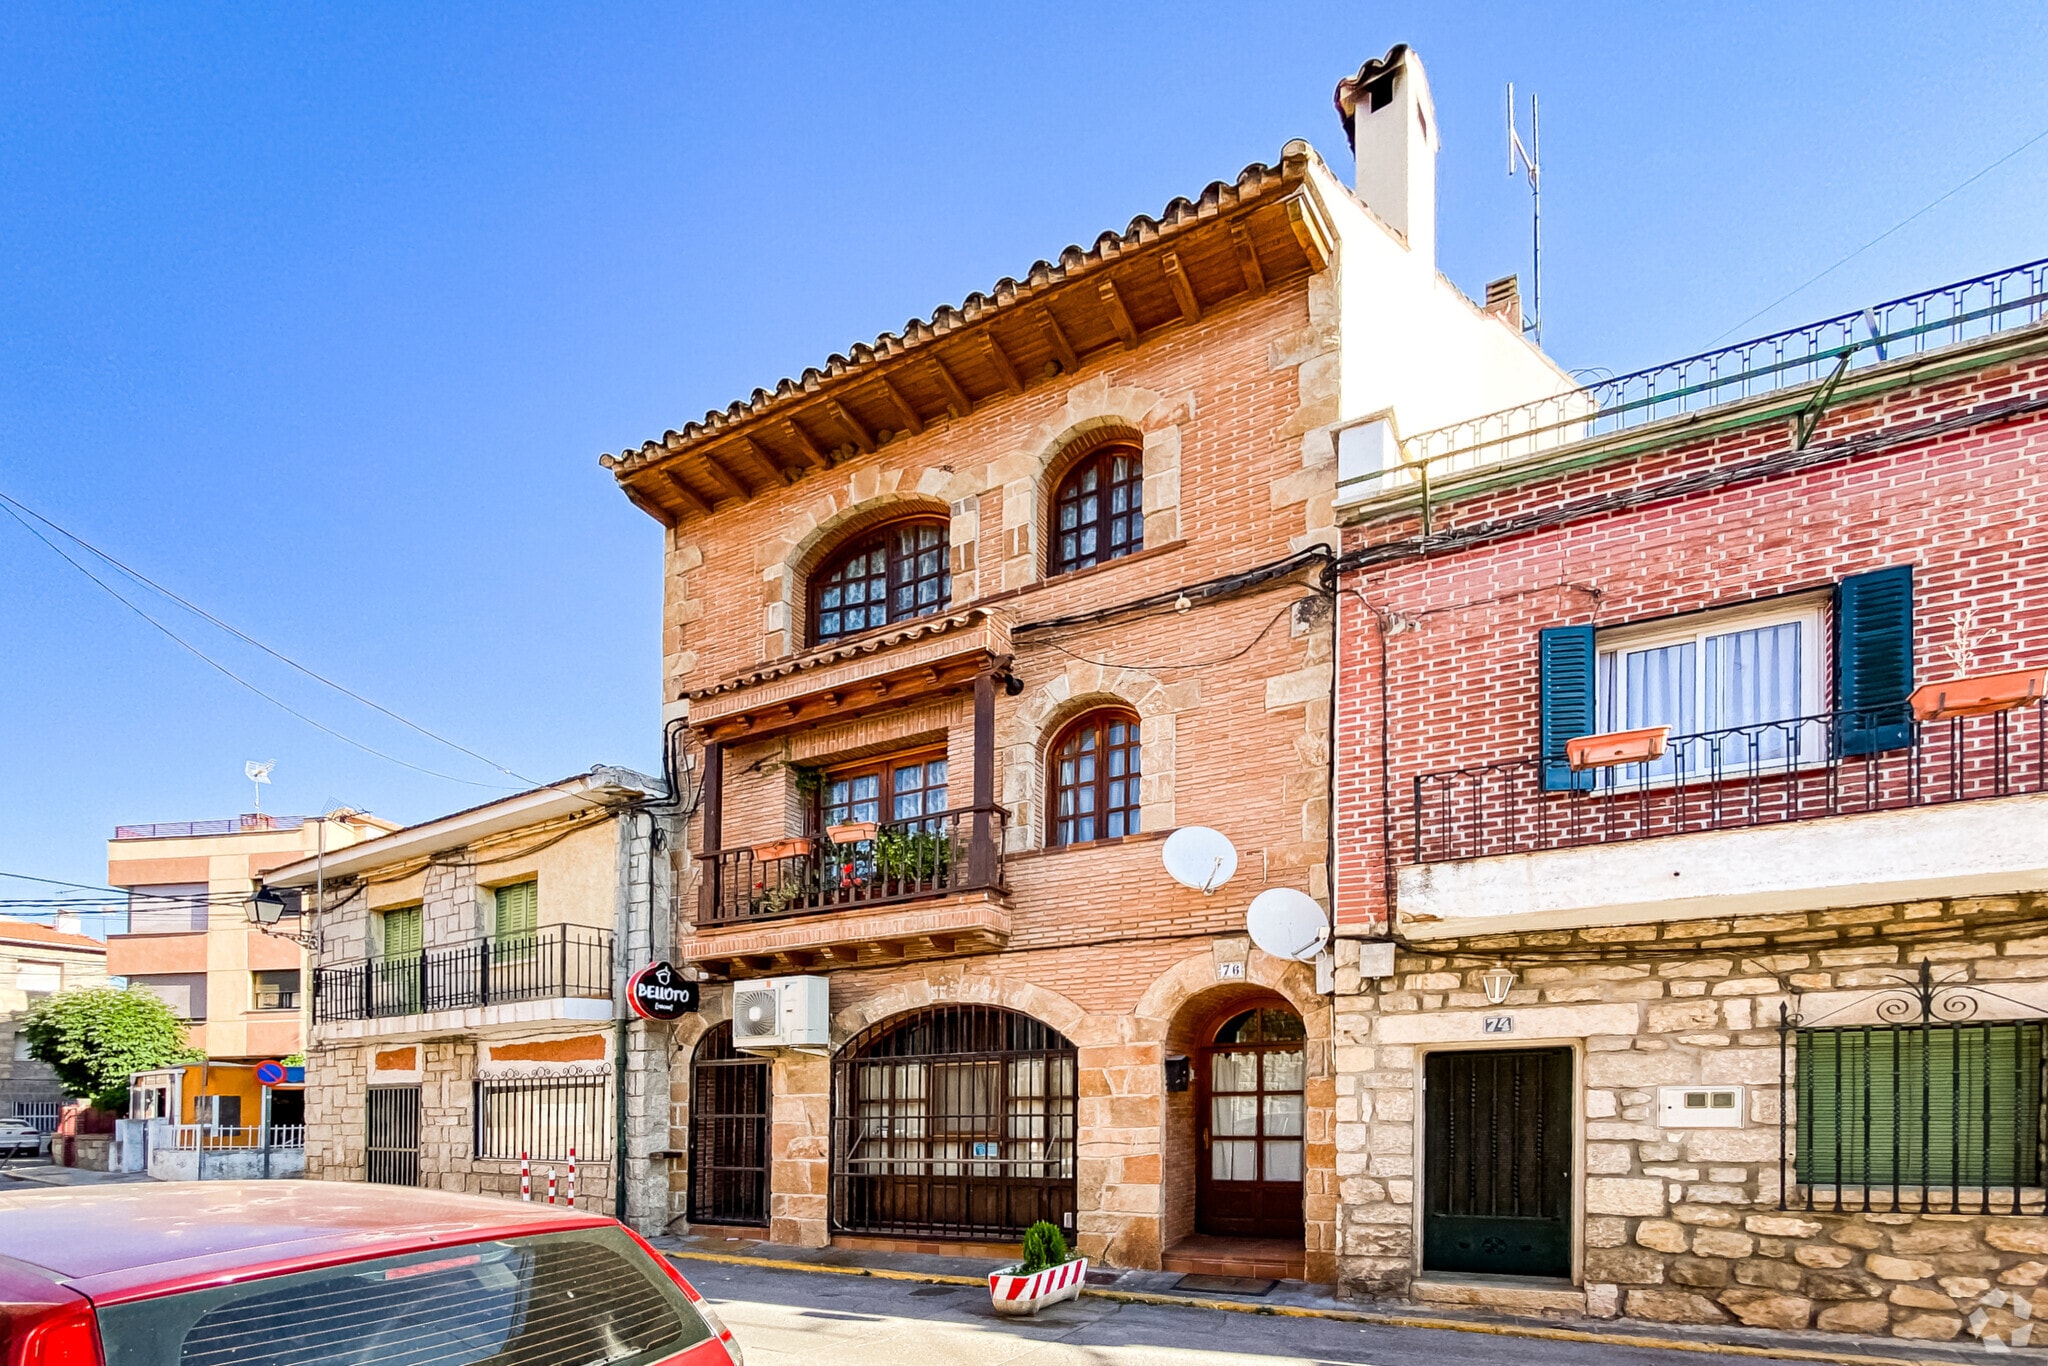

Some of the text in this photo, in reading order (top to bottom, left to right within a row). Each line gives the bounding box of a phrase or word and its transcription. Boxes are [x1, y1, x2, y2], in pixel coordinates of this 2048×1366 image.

[1222, 964, 1240, 976] 76
[638, 983, 690, 1003] BELLOTO
[1486, 1017, 1511, 1032] 74
